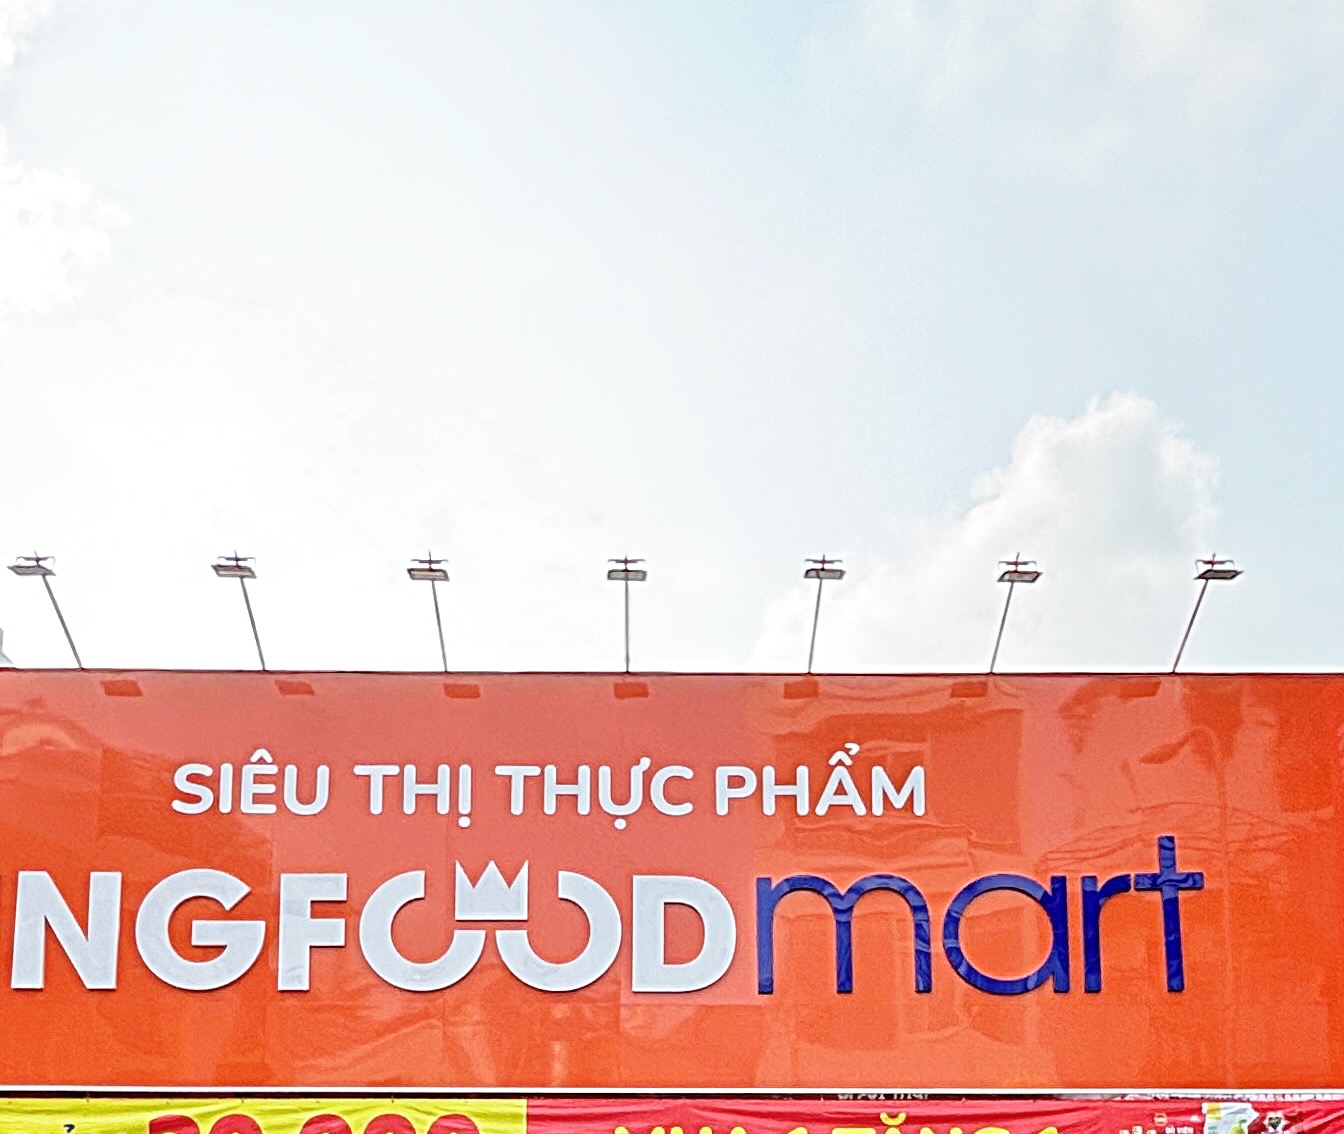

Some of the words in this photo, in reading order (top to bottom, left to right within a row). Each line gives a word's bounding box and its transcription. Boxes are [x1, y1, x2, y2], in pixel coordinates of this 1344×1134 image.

[172, 748, 330, 815] SIÊU
[353, 763, 471, 828] THỊ
[495, 756, 696, 829] THỰC
[716, 743, 927, 818] PHẨM
